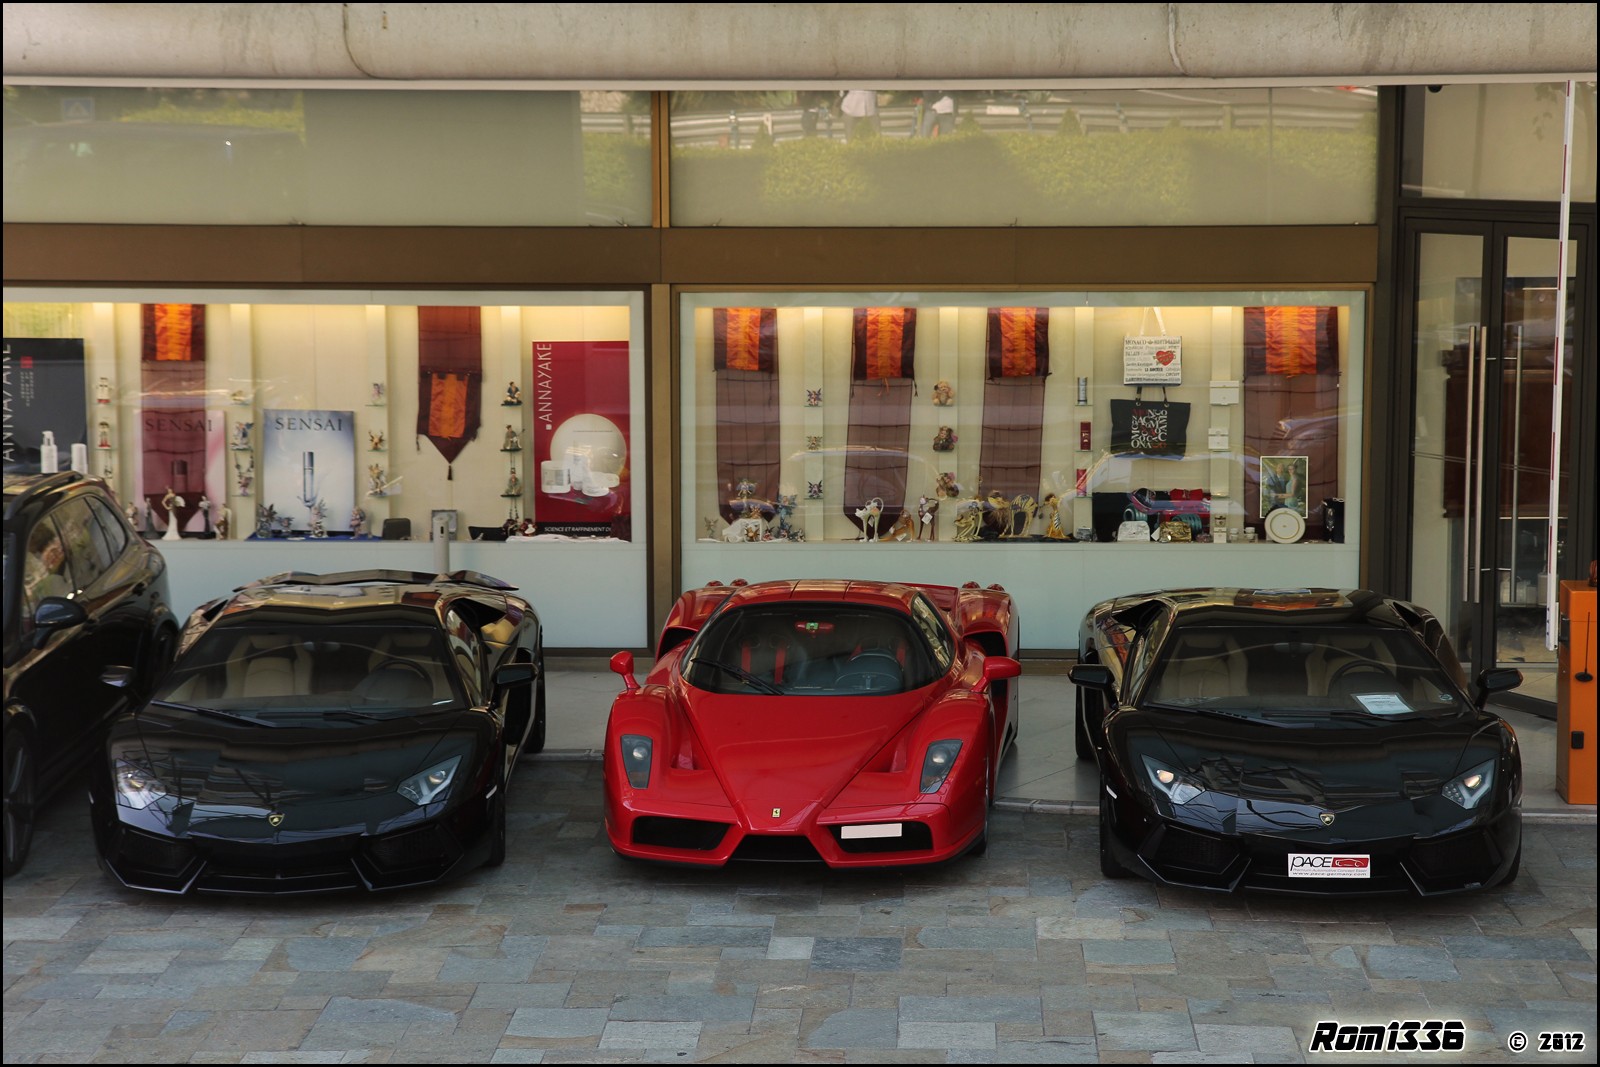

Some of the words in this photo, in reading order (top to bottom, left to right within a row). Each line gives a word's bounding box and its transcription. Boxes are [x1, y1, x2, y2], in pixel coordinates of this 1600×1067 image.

[536, 343, 552, 423] ANNAYAKE
[145, 418, 213, 432] SENSAI
[275, 417, 343, 431] SENSAI
